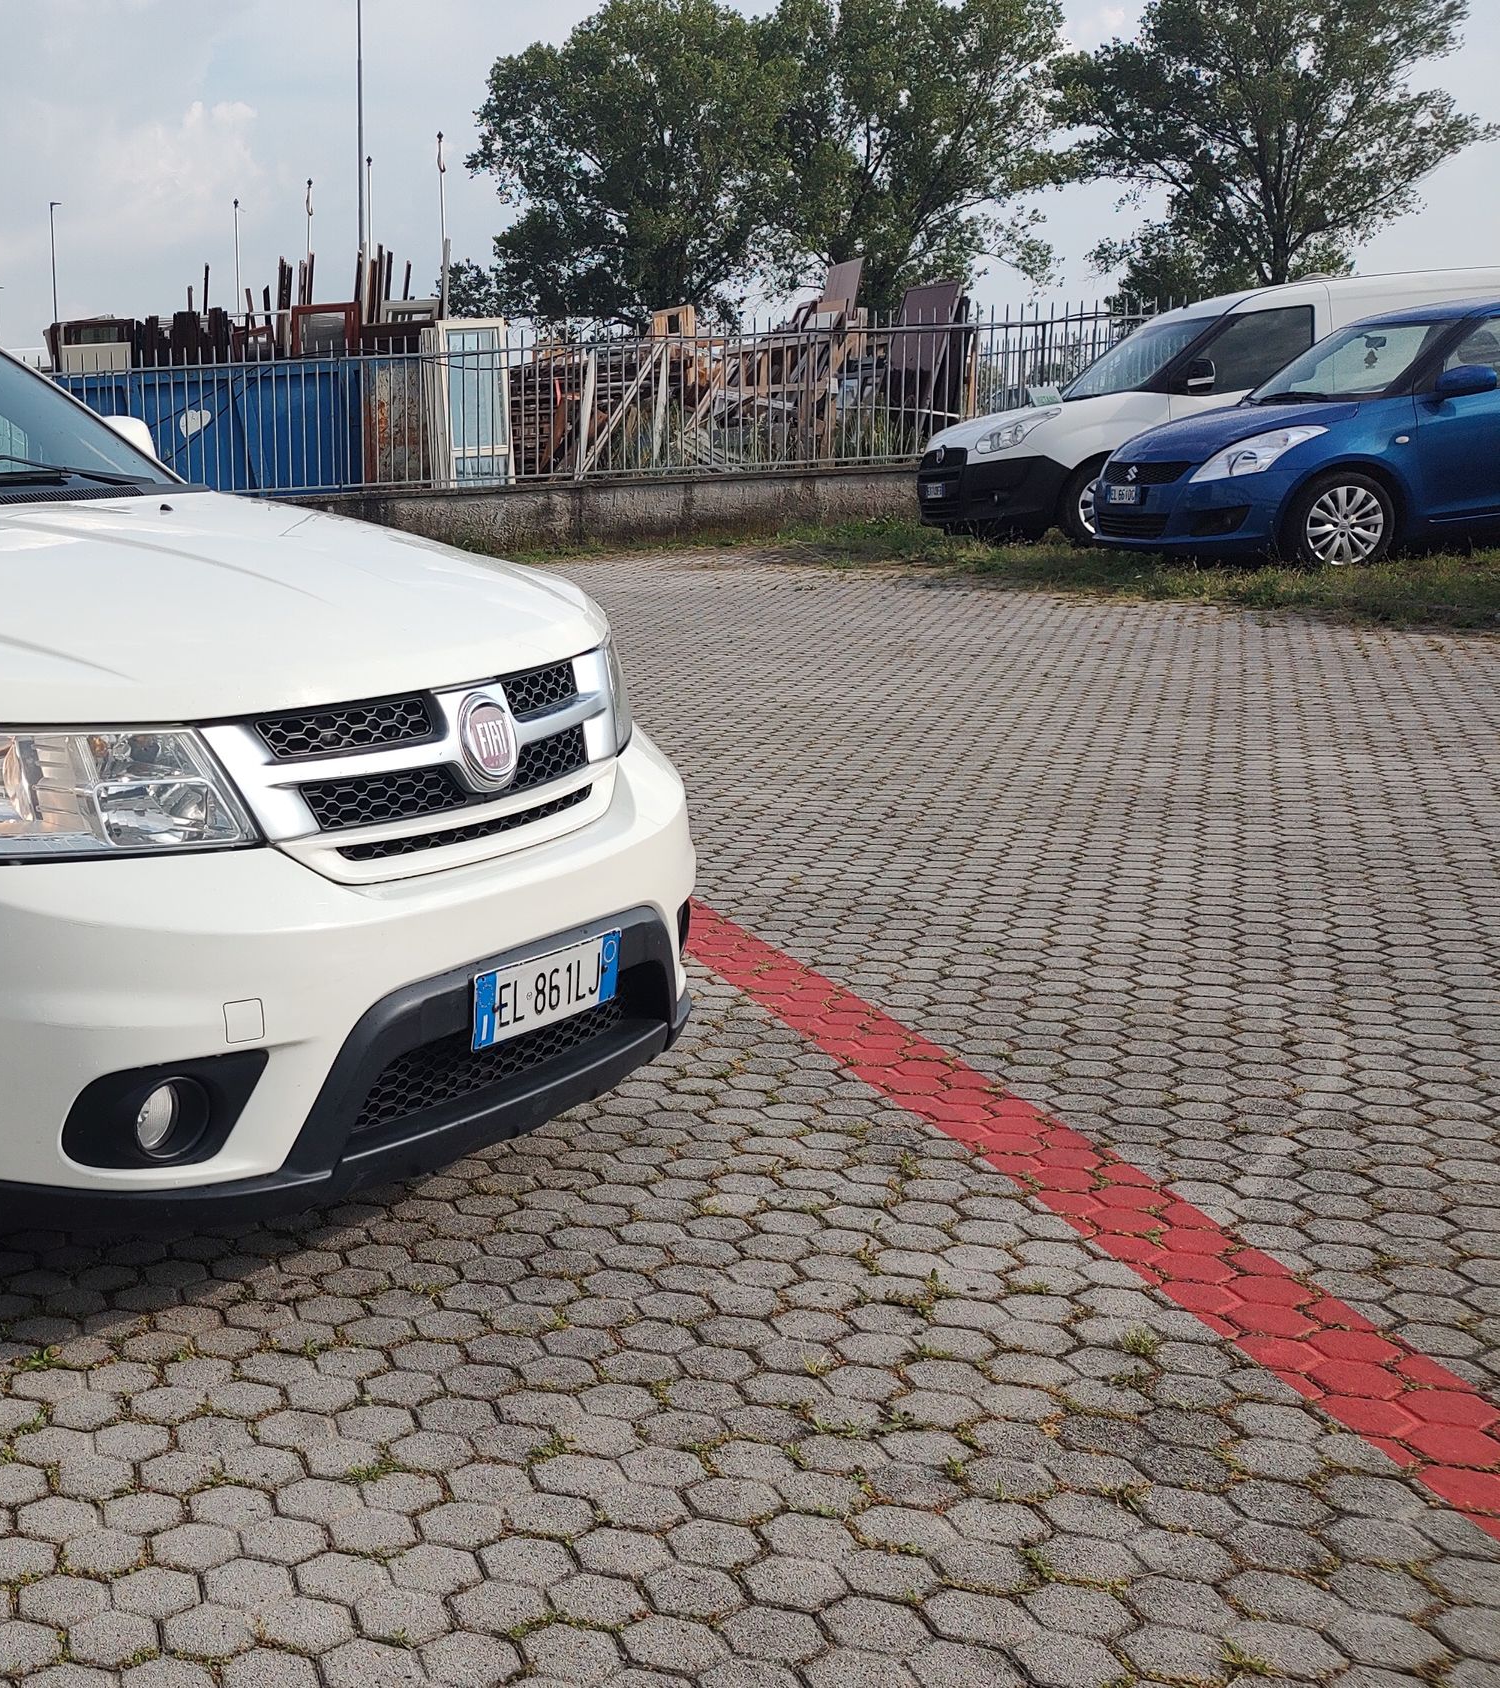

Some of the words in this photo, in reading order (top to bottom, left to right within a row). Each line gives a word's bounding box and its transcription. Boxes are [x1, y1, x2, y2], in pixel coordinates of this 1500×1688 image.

[475, 719, 508, 759] FIAT
[498, 980, 525, 1028] EL
[534, 952, 601, 1016] 861LJ
